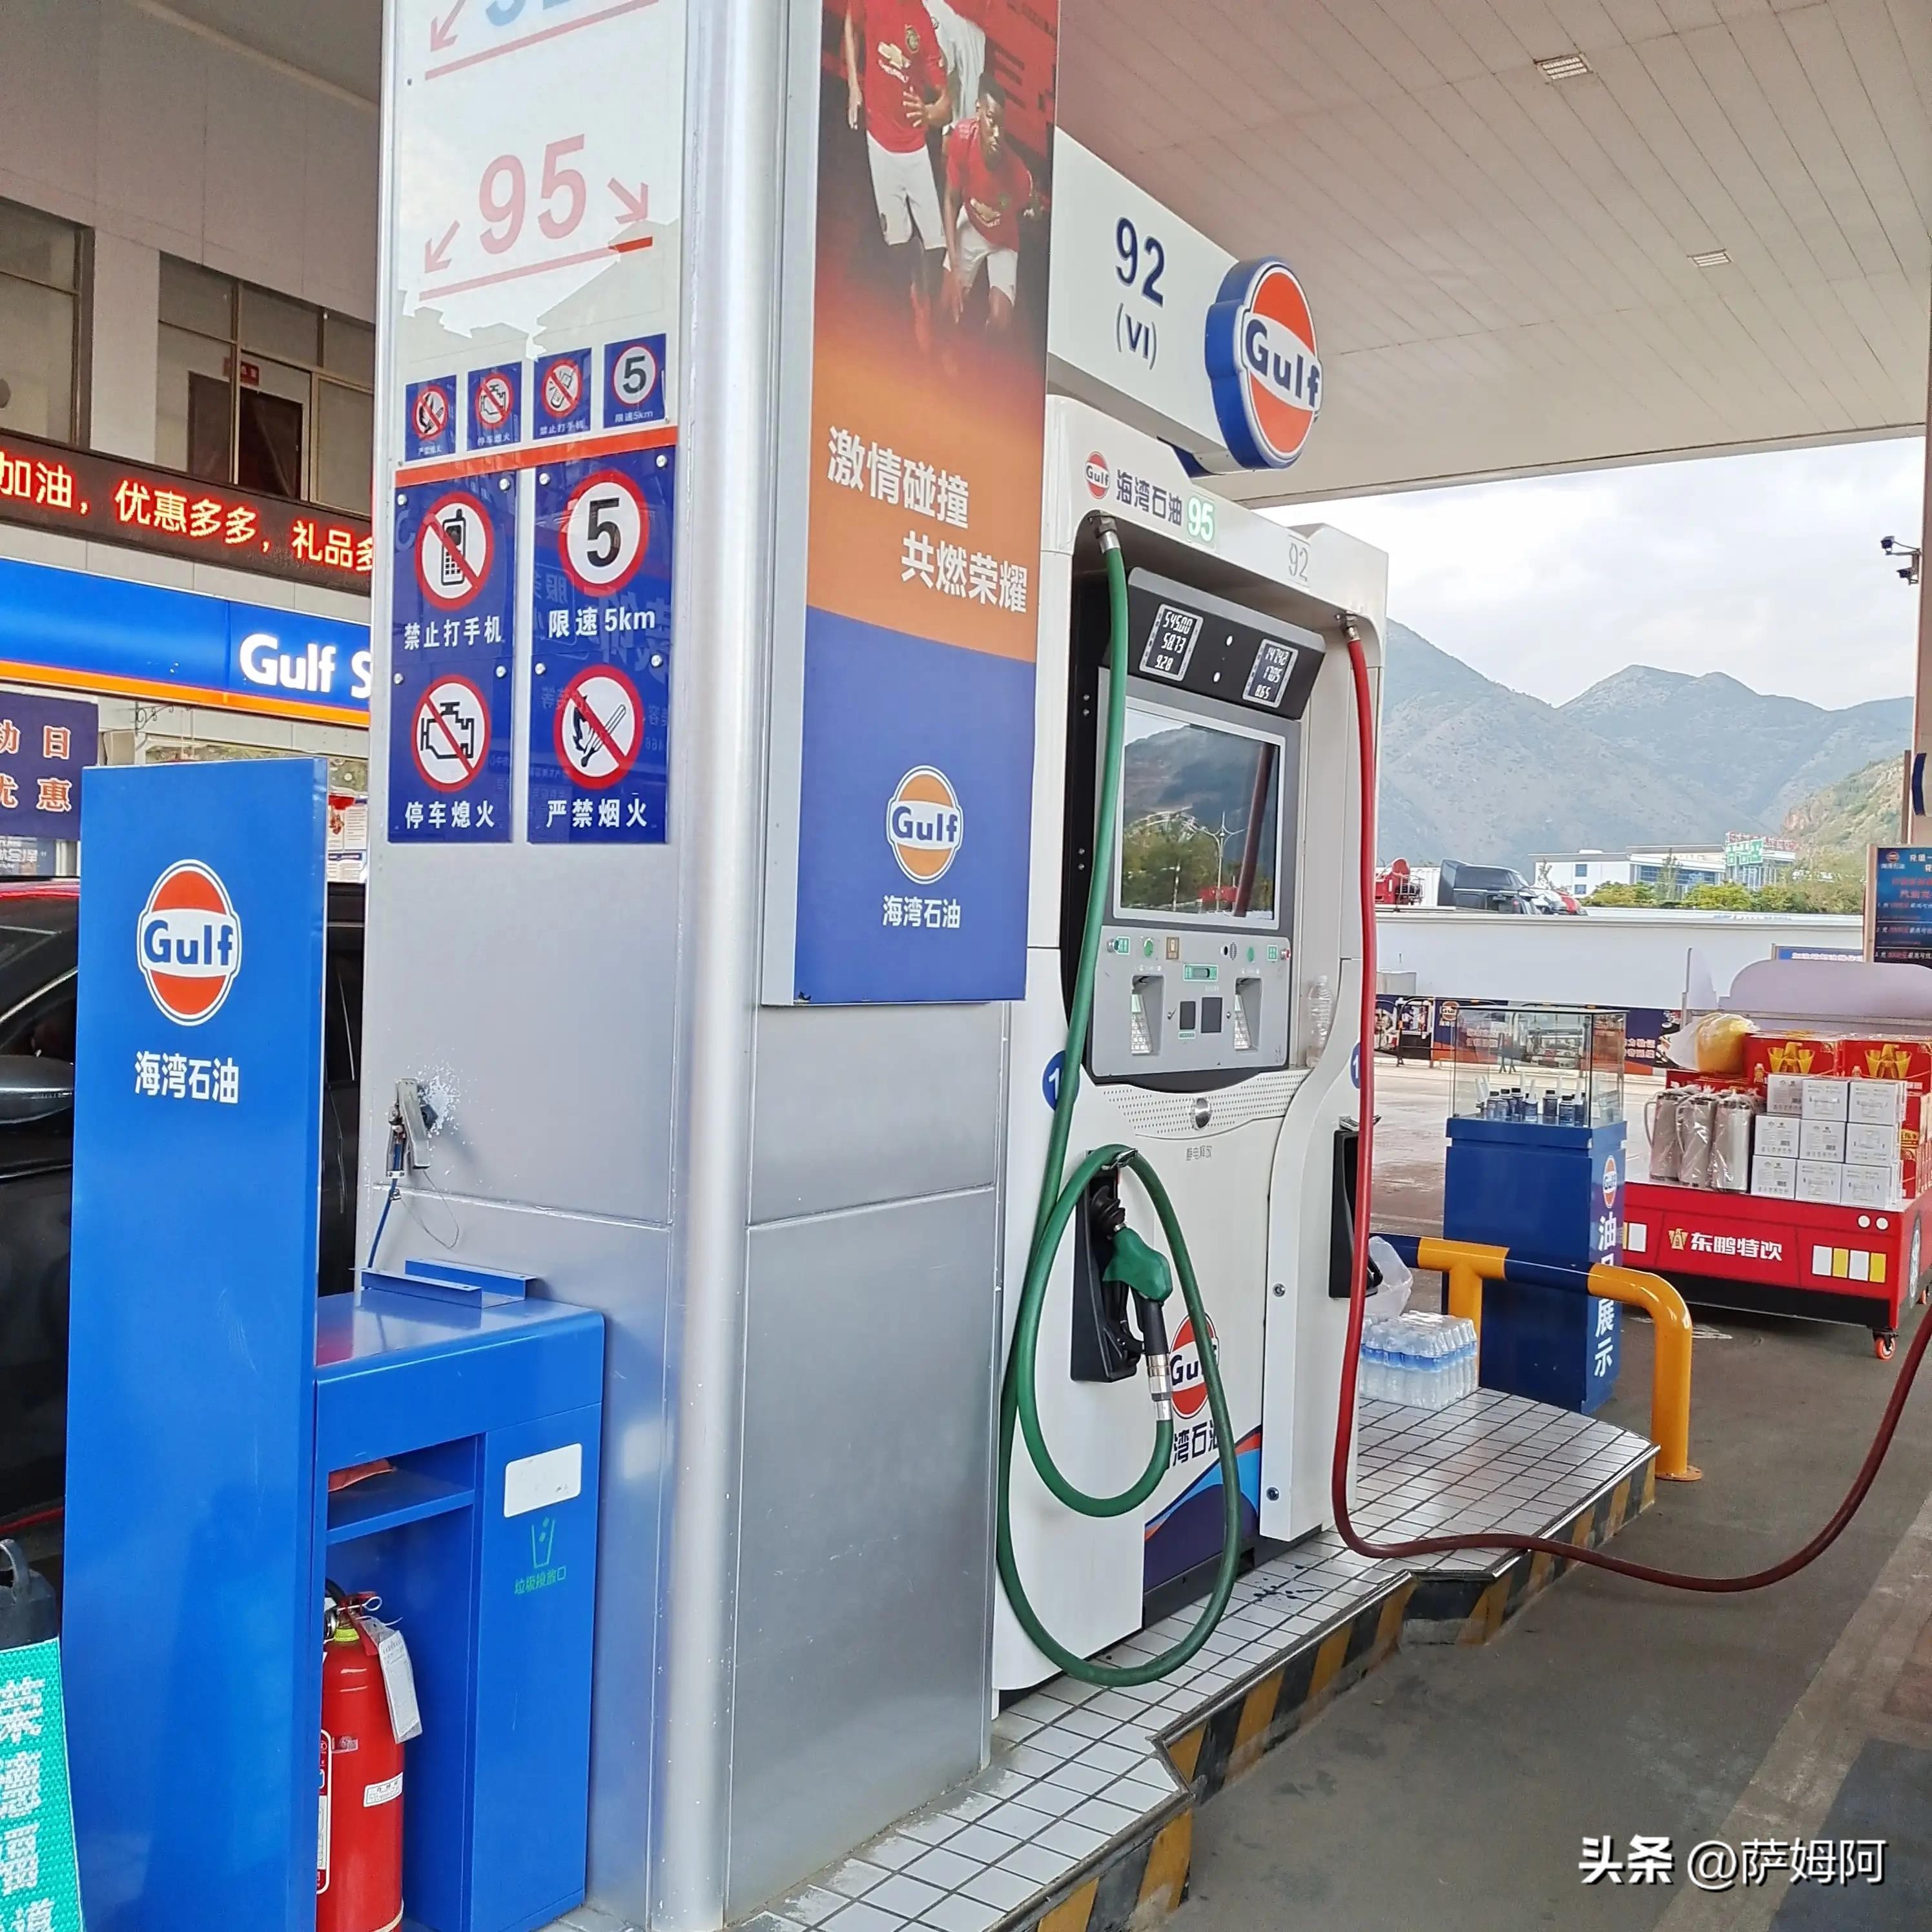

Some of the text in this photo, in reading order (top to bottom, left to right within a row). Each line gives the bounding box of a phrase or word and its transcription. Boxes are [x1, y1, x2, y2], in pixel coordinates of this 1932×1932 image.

[478, 134, 586, 254] 95
[1115, 217, 1165, 308] 92
[1116, 303, 1157, 370] (VI)
[622, 355, 646, 395] 5
[1246, 318, 1321, 408] Gulf
[827, 425, 969, 529] 激情碰撞
[1085, 464, 1109, 488] Gulf
[1116, 469, 1184, 527] 海湾石油
[586, 497, 621, 568] 5
[1187, 497, 1215, 541] 95
[901, 529, 1028, 614] 共燃荣耀
[1288, 544, 1310, 582] 92
[404, 615, 502, 651] 禁止打手机
[548, 606, 656, 639] 限速5km
[240, 633, 336, 694] Gulf
[404, 799, 495, 830] 停车熄火
[545, 797, 648, 829] 严禁烟火
[892, 805, 958, 843] Gulf
[881, 894, 961, 929] 海湾石油
[143, 920, 235, 967] Gulf
[134, 1050, 240, 1104] 海湾石油
[1690, 1231, 1783, 1262] 东鹏特饮
